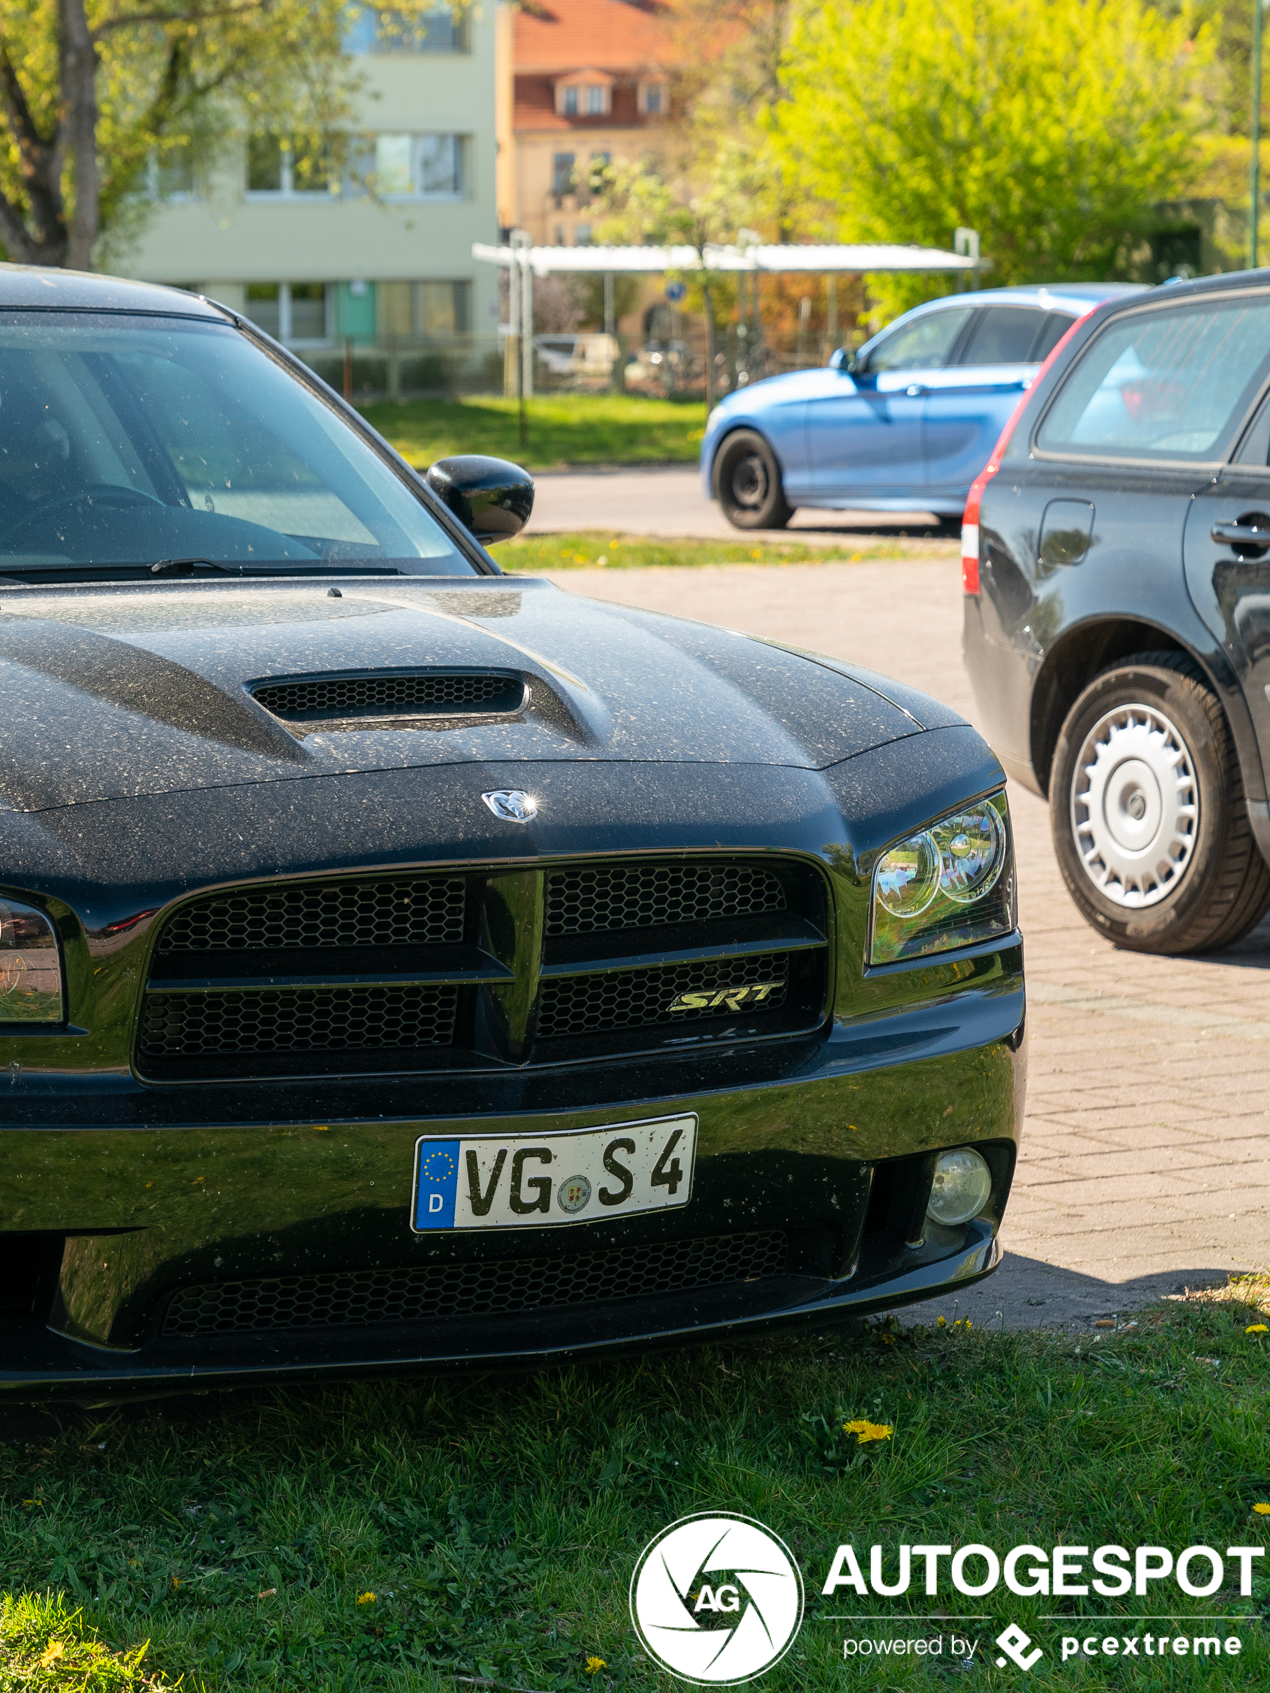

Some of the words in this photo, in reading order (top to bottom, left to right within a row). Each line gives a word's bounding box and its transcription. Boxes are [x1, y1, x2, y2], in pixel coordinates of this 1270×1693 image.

[666, 980, 786, 1011] SRT
[465, 1146, 553, 1216] VG
[598, 1136, 636, 1206] S
[649, 1128, 684, 1195] 4
[428, 1193, 444, 1213] D
